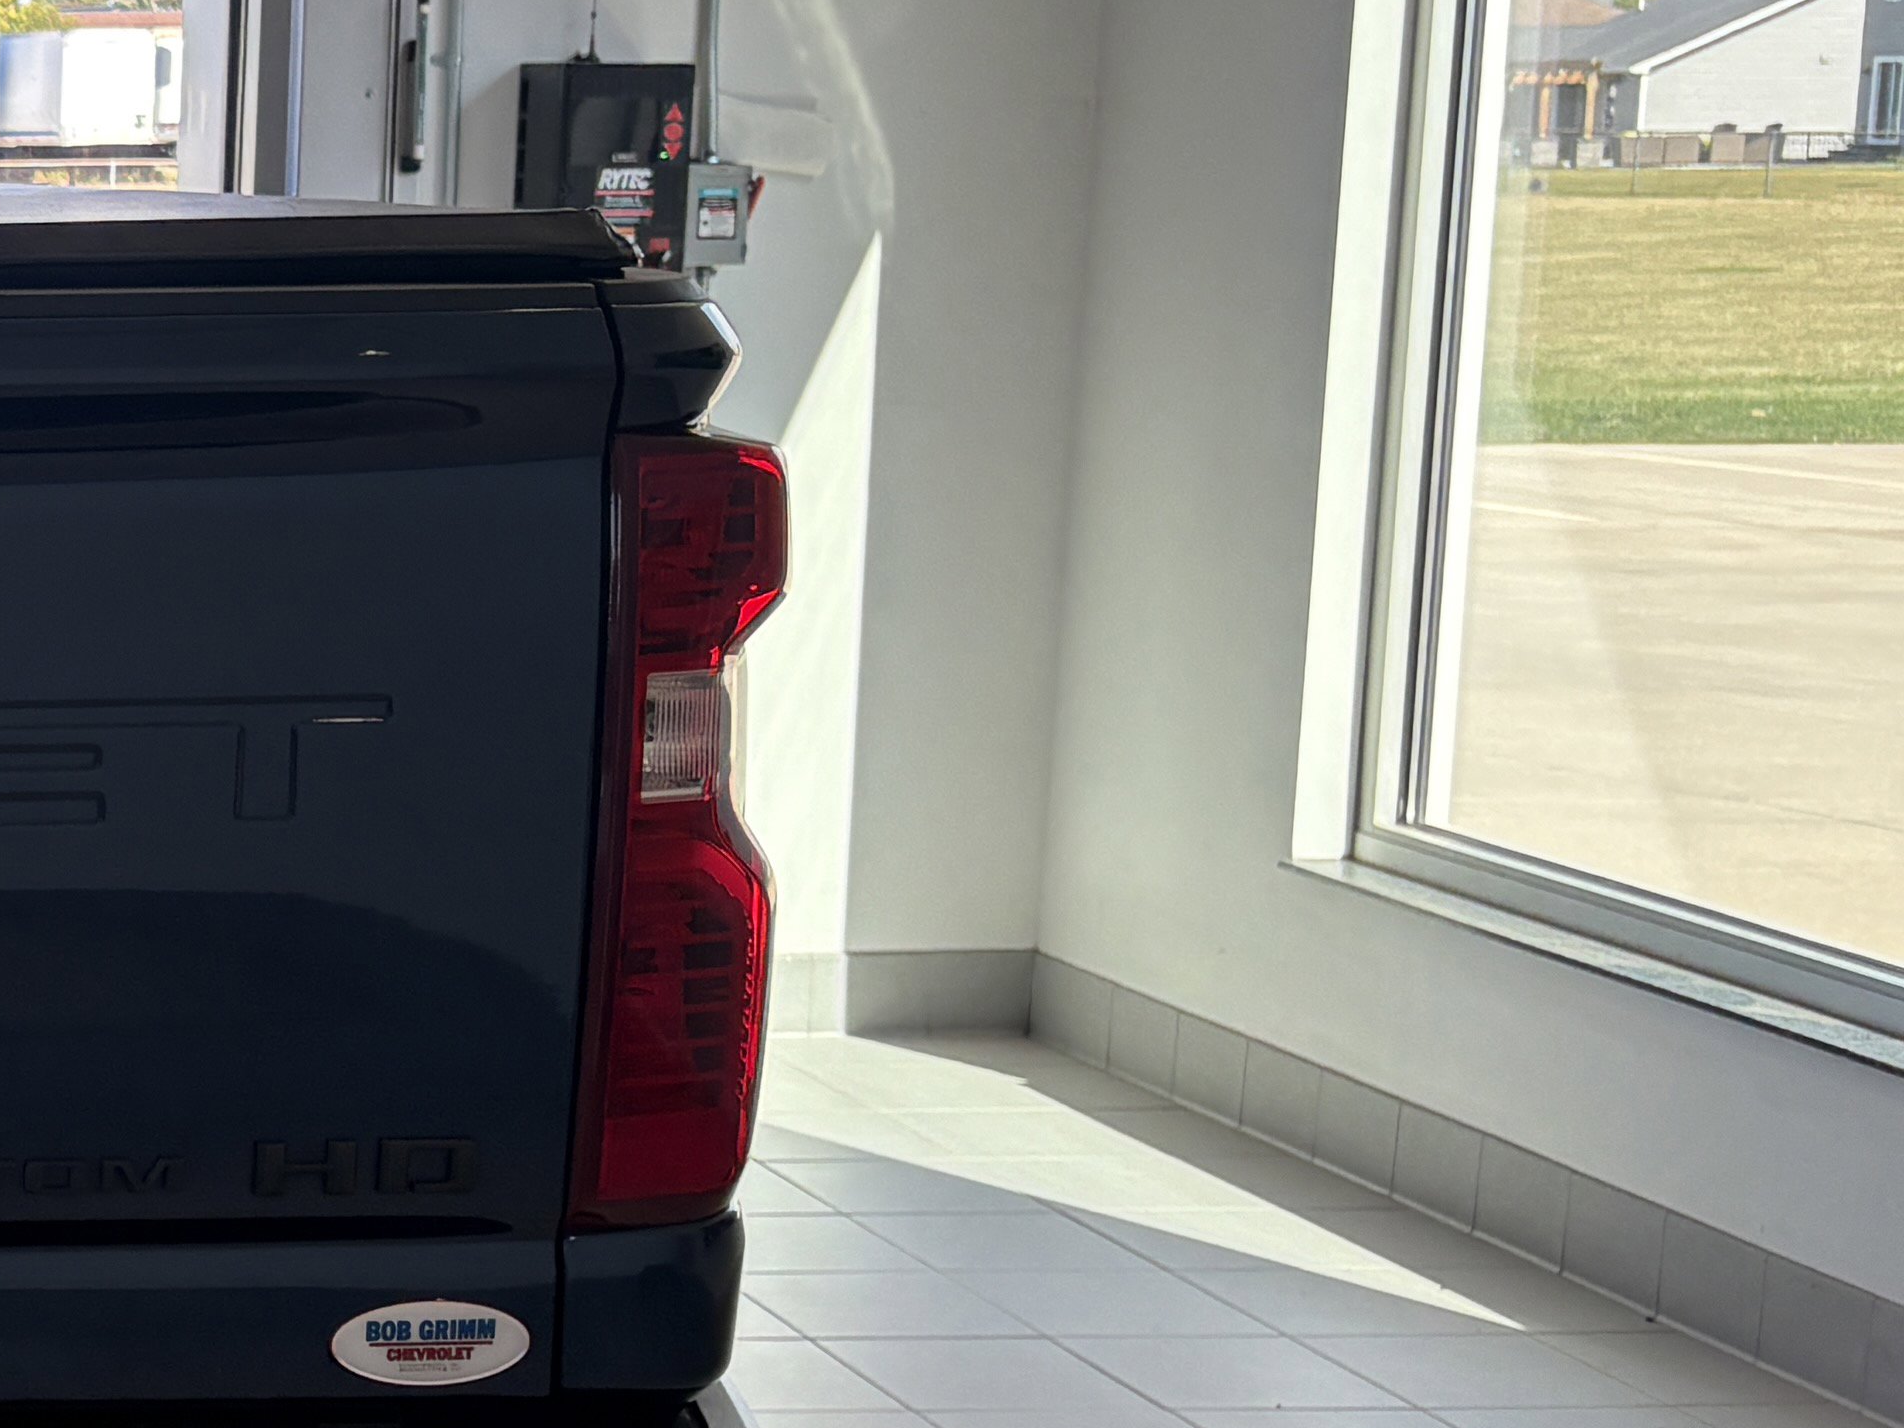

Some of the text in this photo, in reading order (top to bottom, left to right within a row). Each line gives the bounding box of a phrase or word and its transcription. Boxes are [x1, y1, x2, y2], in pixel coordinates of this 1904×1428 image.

[250, 1136, 479, 1198] HD
[365, 1318, 496, 1342] BOB GRIMM
[386, 1346, 474, 1362] CHEVROLET
